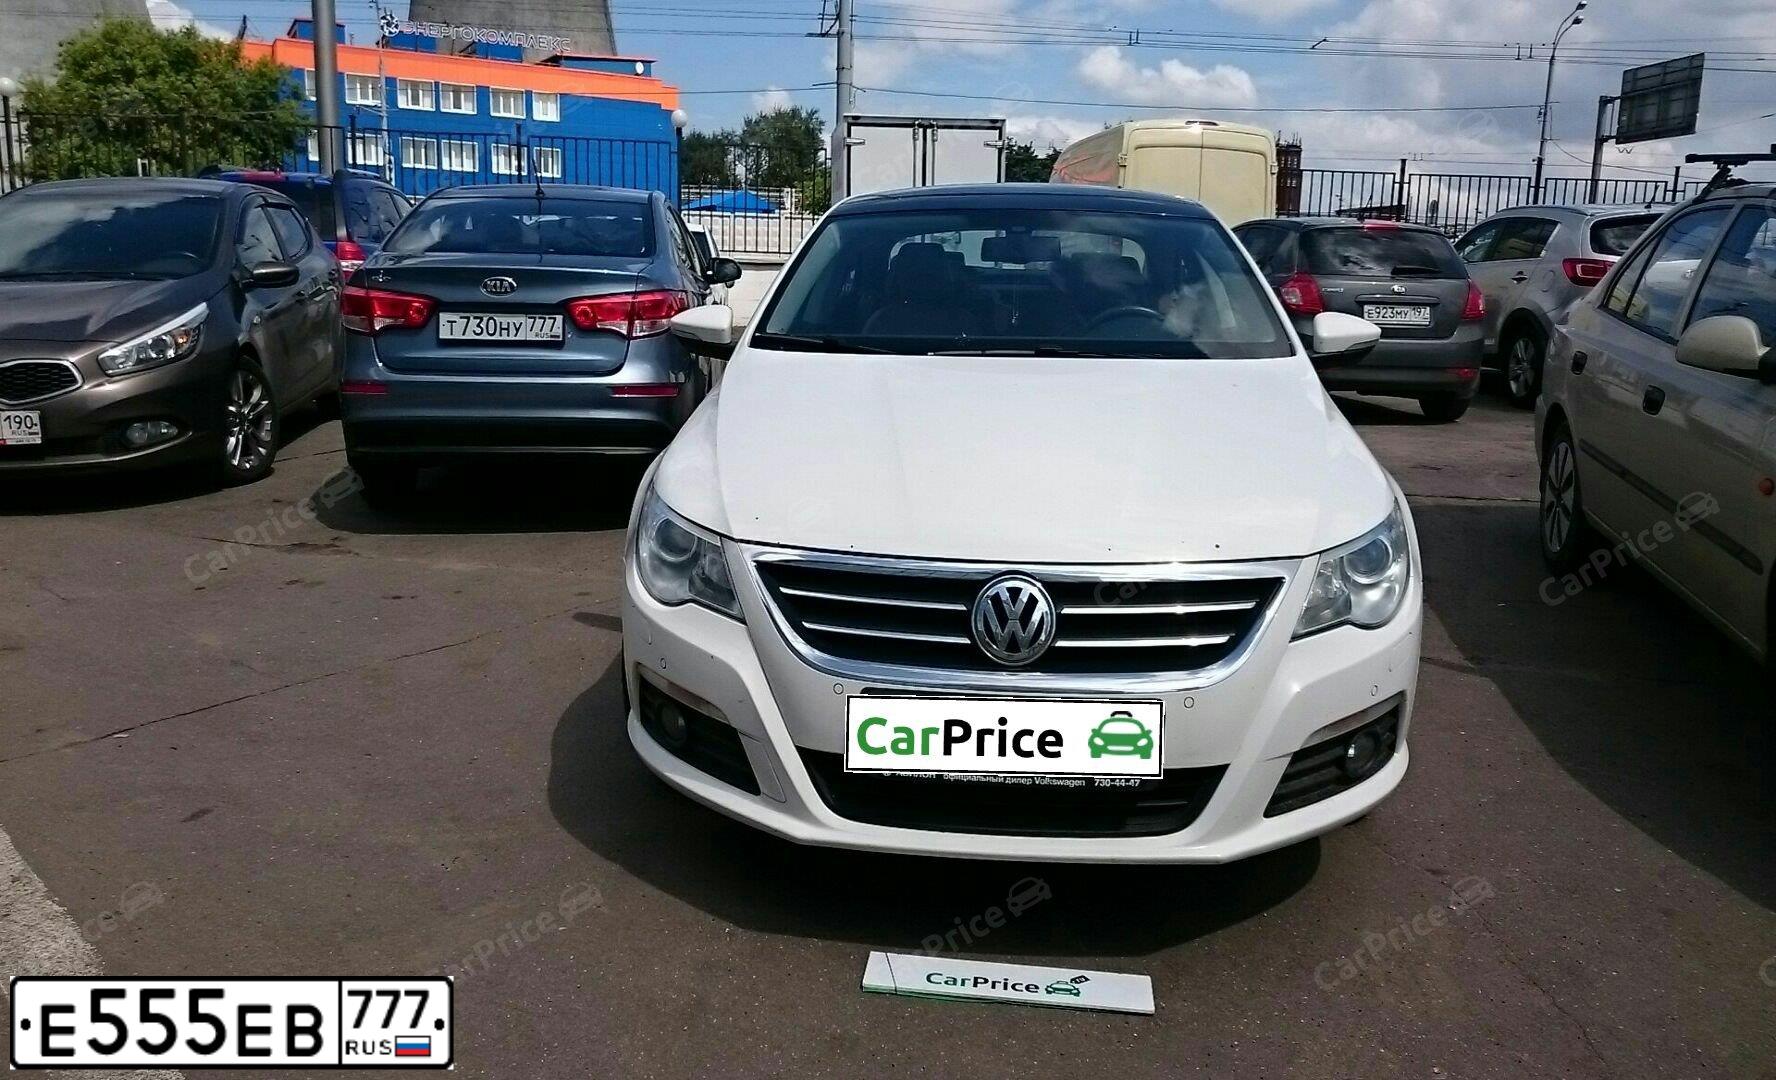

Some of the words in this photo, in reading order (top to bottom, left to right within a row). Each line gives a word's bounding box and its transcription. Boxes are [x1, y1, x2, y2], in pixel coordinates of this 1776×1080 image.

[403, 21, 571, 52] ЭНЕРГОКОМПЛЕКС
[486, 280, 511, 292] KIA
[528, 316, 557, 332] 777
[3, 415, 34, 430] 190
[1034, 776, 1086, 788] Volkswagen
[1094, 778, 1141, 788] 730-44-47
[925, 972, 1040, 994] CarPrice
